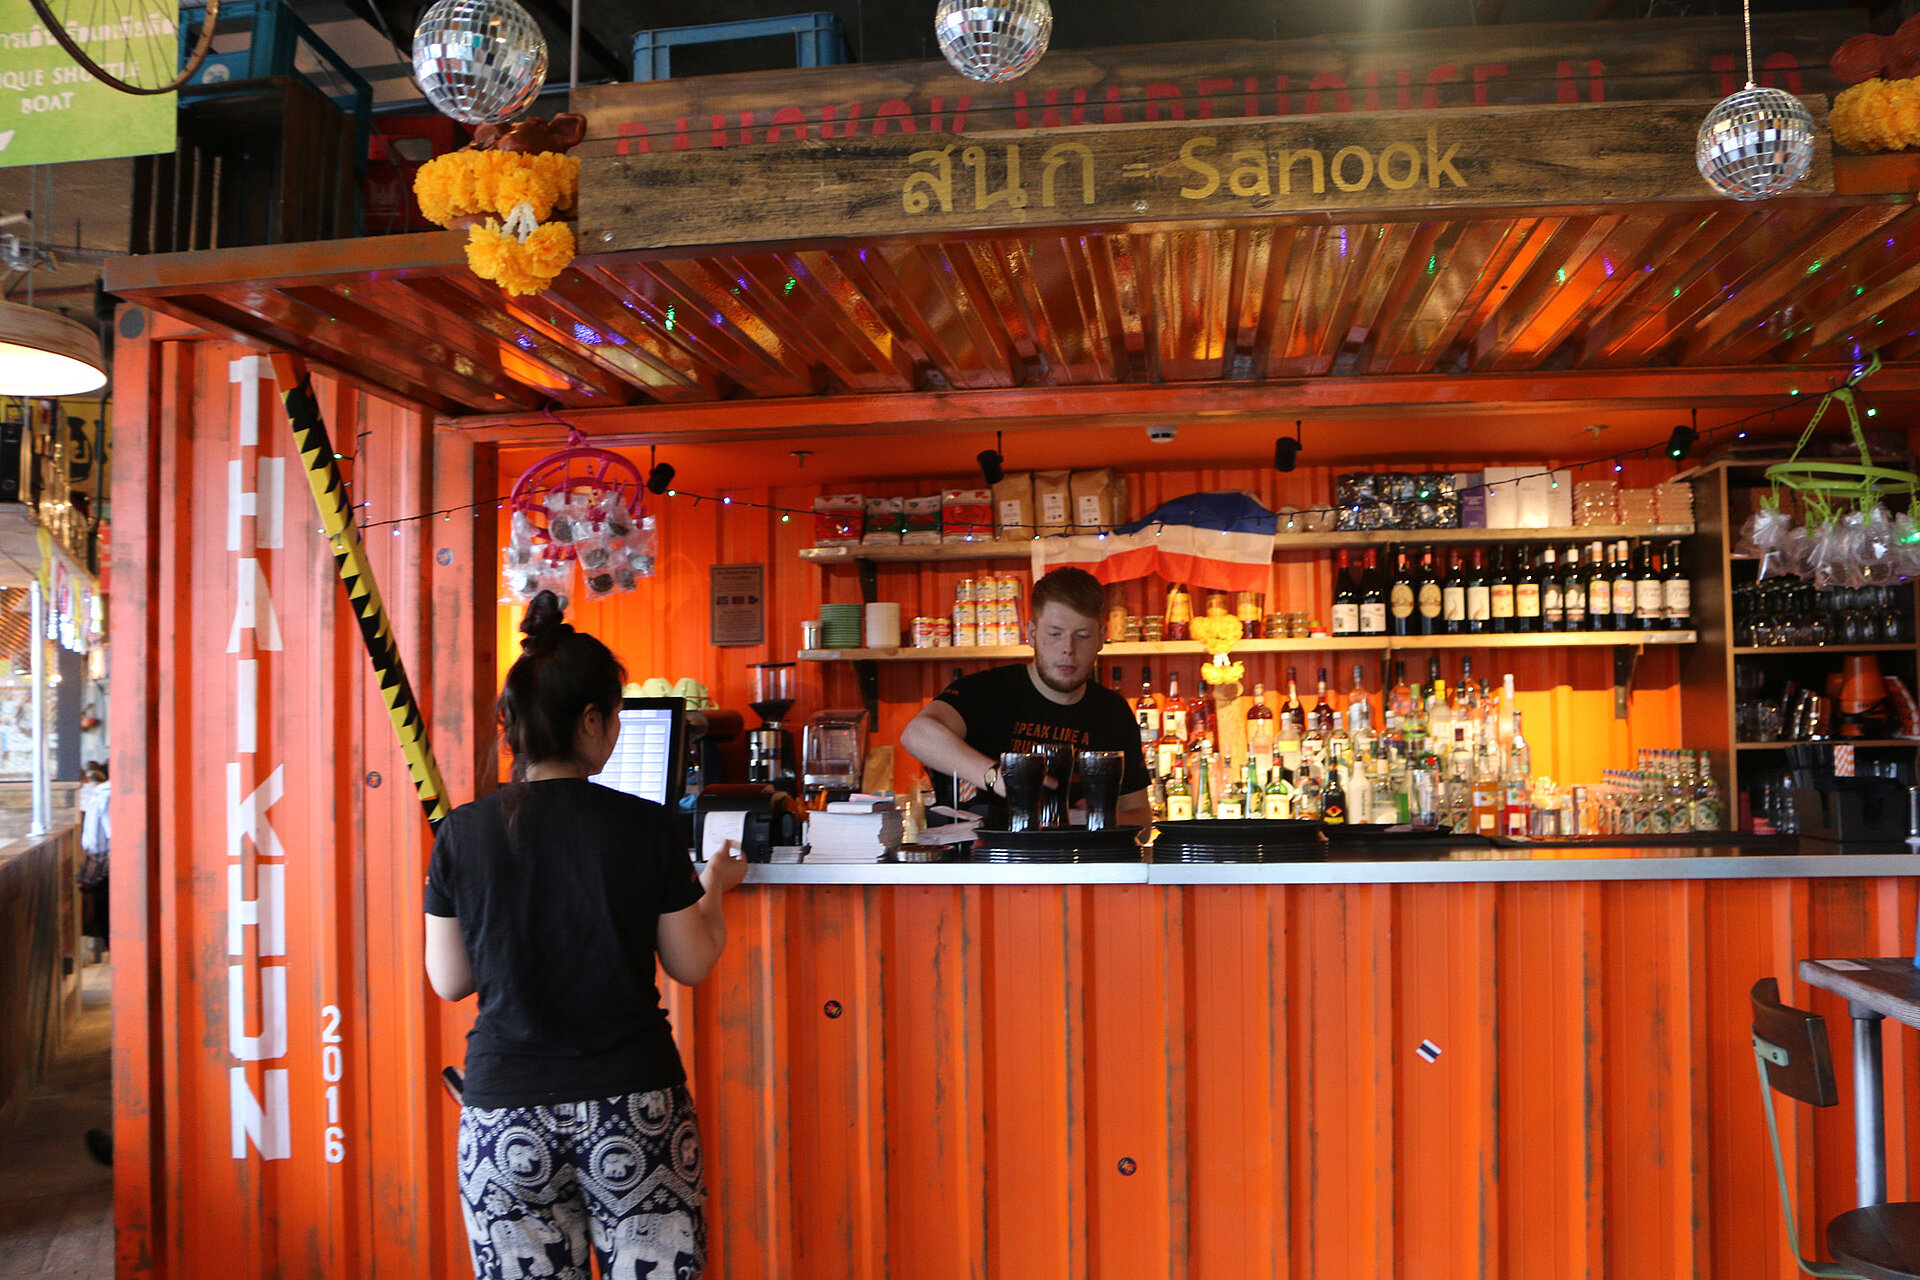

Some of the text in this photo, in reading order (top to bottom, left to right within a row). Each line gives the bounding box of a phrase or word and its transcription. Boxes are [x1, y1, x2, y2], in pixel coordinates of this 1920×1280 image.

[21, 92, 76, 114] BOAT
[902, 142, 1096, 223] สนุก
[1179, 127, 1468, 200] Sanook
[1052, 726, 1081, 744] LIKE
[1081, 731, 1090, 746] A
[321, 1005, 346, 1164] 2016
